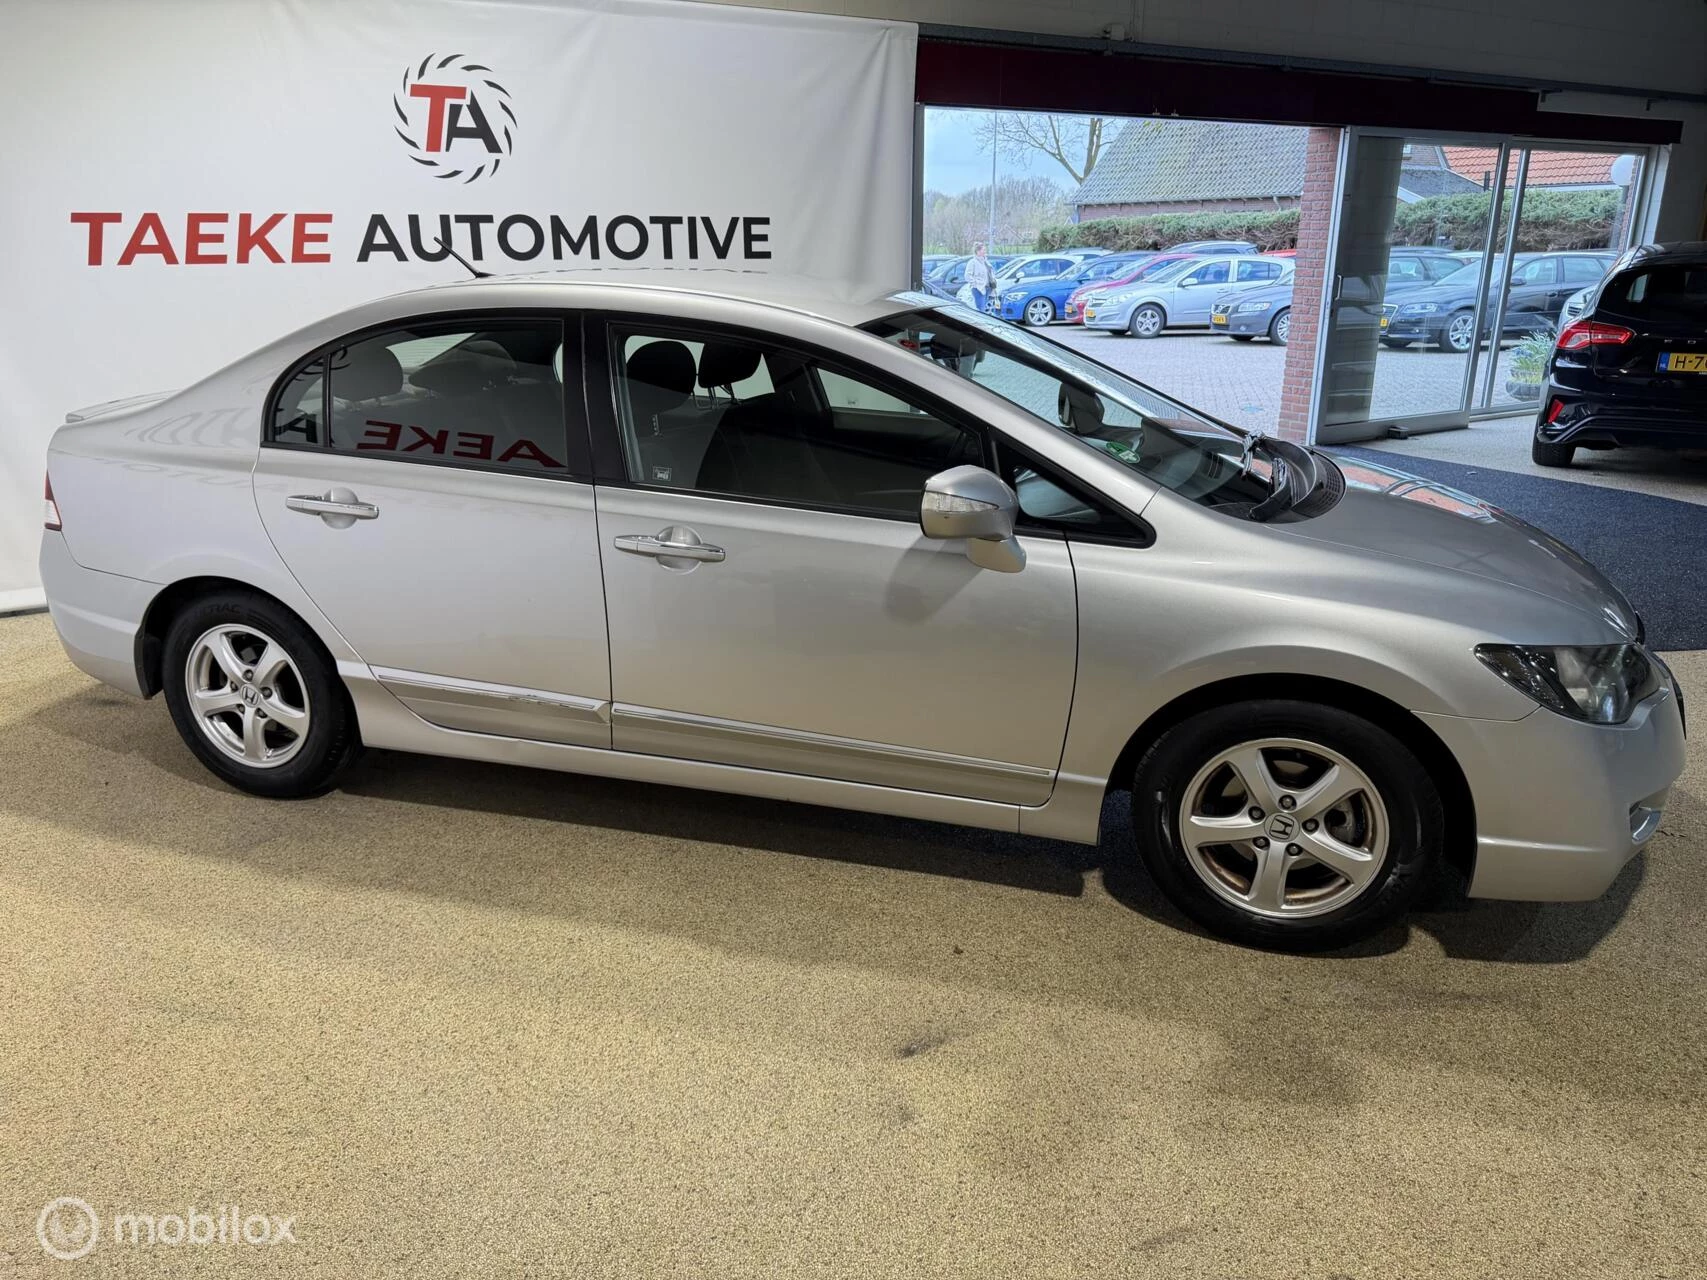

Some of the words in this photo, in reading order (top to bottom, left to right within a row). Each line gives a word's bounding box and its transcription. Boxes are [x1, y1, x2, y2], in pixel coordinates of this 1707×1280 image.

[410, 83, 503, 153] TA
[70, 212, 333, 266] TAEKE
[356, 213, 772, 262] AUTOMOTIVE
[1673, 355, 1707, 369] H-7
